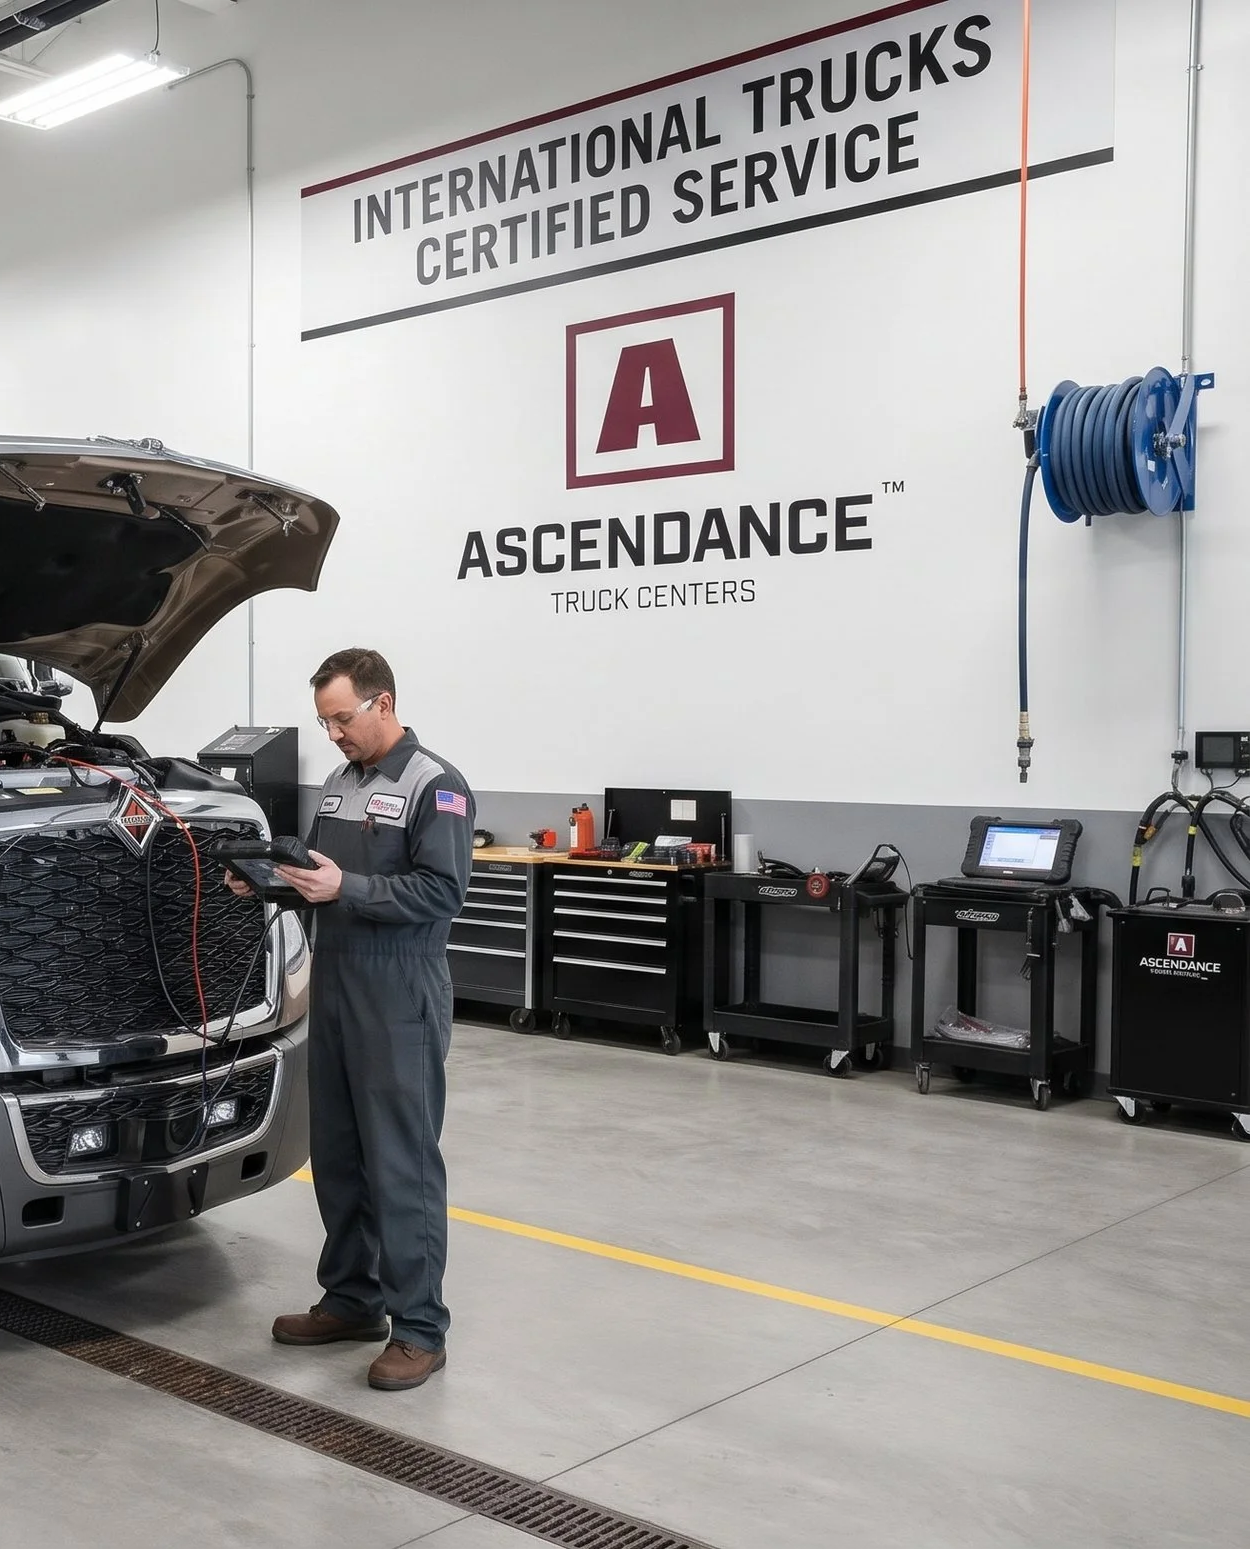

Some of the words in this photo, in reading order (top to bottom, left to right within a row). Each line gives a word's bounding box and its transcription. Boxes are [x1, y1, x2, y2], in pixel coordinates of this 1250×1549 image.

[353, 96, 722, 244] INTERNATIONAL
[741, 15, 992, 135] TRUCKS
[416, 184, 652, 286] CERTIFIED
[672, 111, 920, 224] SERVICE
[596, 338, 701, 454] A
[457, 494, 873, 580] ASCENDANCE
[551, 587, 629, 614] TRUCK
[638, 580, 756, 609] CENTERS
[1139, 957, 1221, 973] ASCENDANCE
[1174, 937, 1188, 952] A
